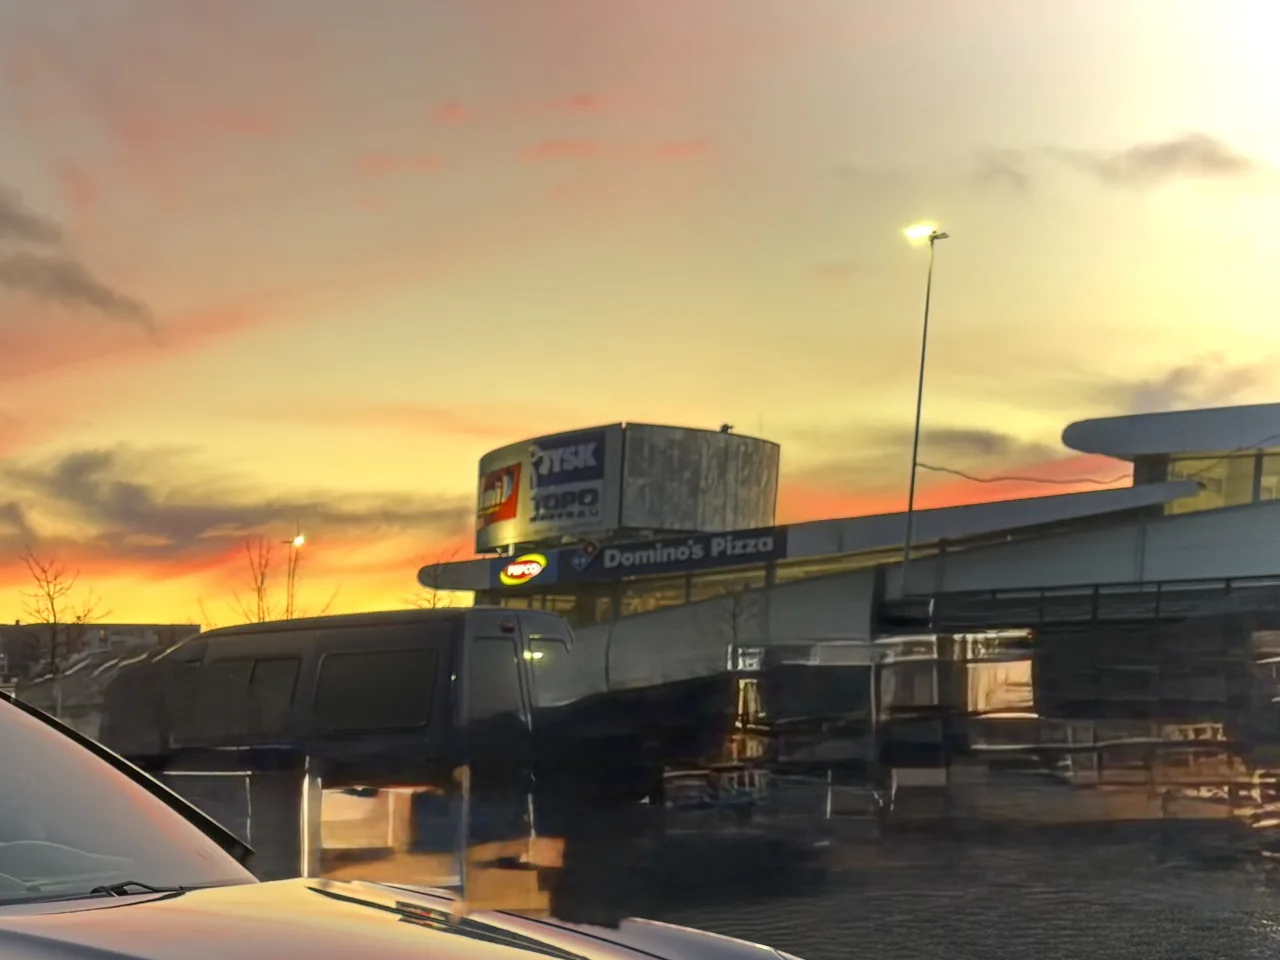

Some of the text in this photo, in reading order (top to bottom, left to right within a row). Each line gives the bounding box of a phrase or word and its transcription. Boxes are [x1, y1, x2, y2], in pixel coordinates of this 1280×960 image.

[538, 441, 598, 475] JYSK
[603, 535, 774, 568] Domino's Pizza
